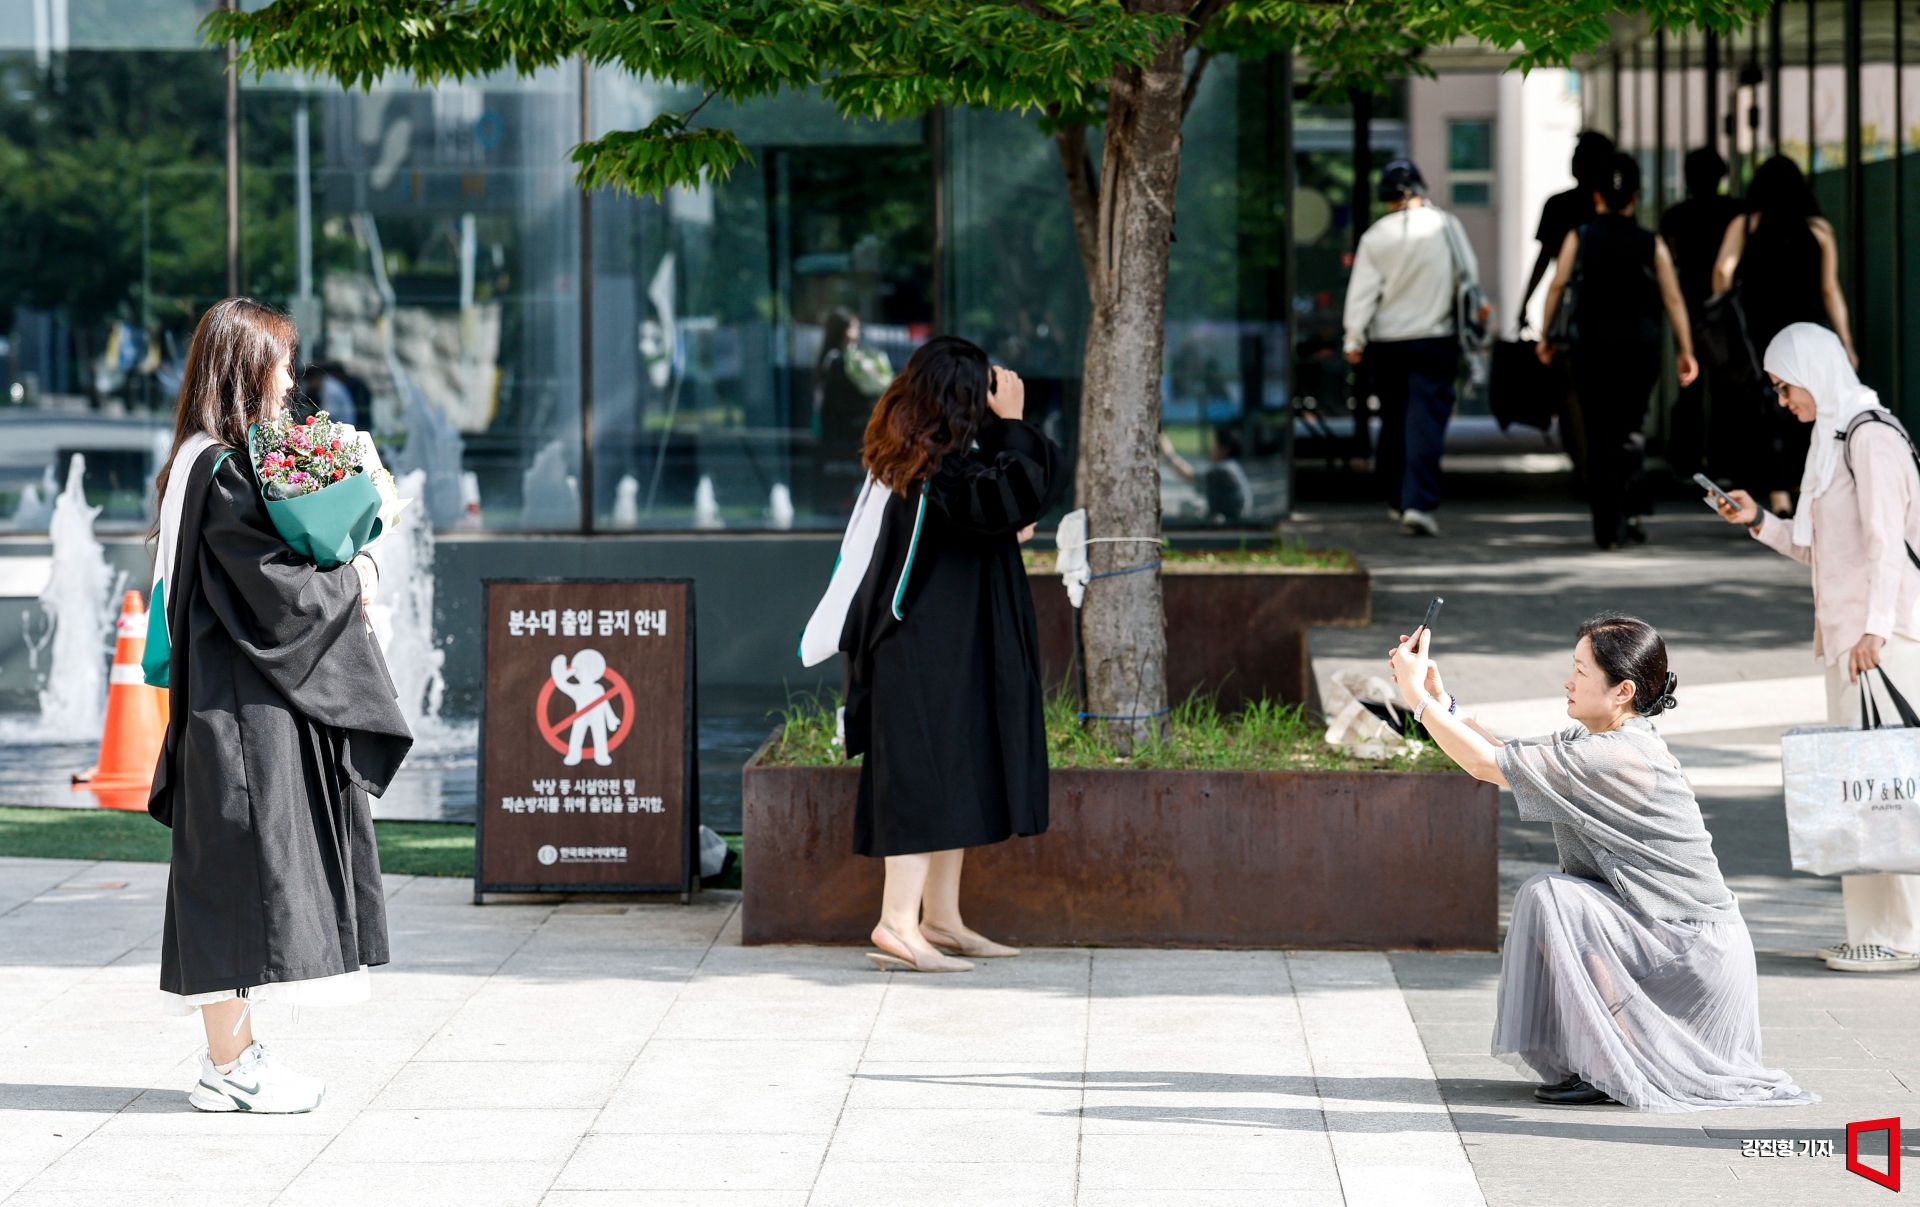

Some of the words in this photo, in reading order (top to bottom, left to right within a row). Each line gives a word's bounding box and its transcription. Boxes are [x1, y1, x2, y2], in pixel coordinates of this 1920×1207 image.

[508, 609, 557, 637] 분수대
[561, 608, 593, 637] 출입
[597, 609, 630, 637] 금지
[634, 609, 667, 637] 안내
[532, 779, 557, 796] 낙상
[559, 779, 571, 796] 등
[573, 779, 620, 796] 시설안전
[623, 779, 636, 796] 및
[1893, 777, 1920, 800] RO
[501, 796, 560, 813] 파손방지를
[563, 796, 587, 813] 위해
[589, 796, 624, 813] 출입을
[627, 796, 666, 813] 금지함.
